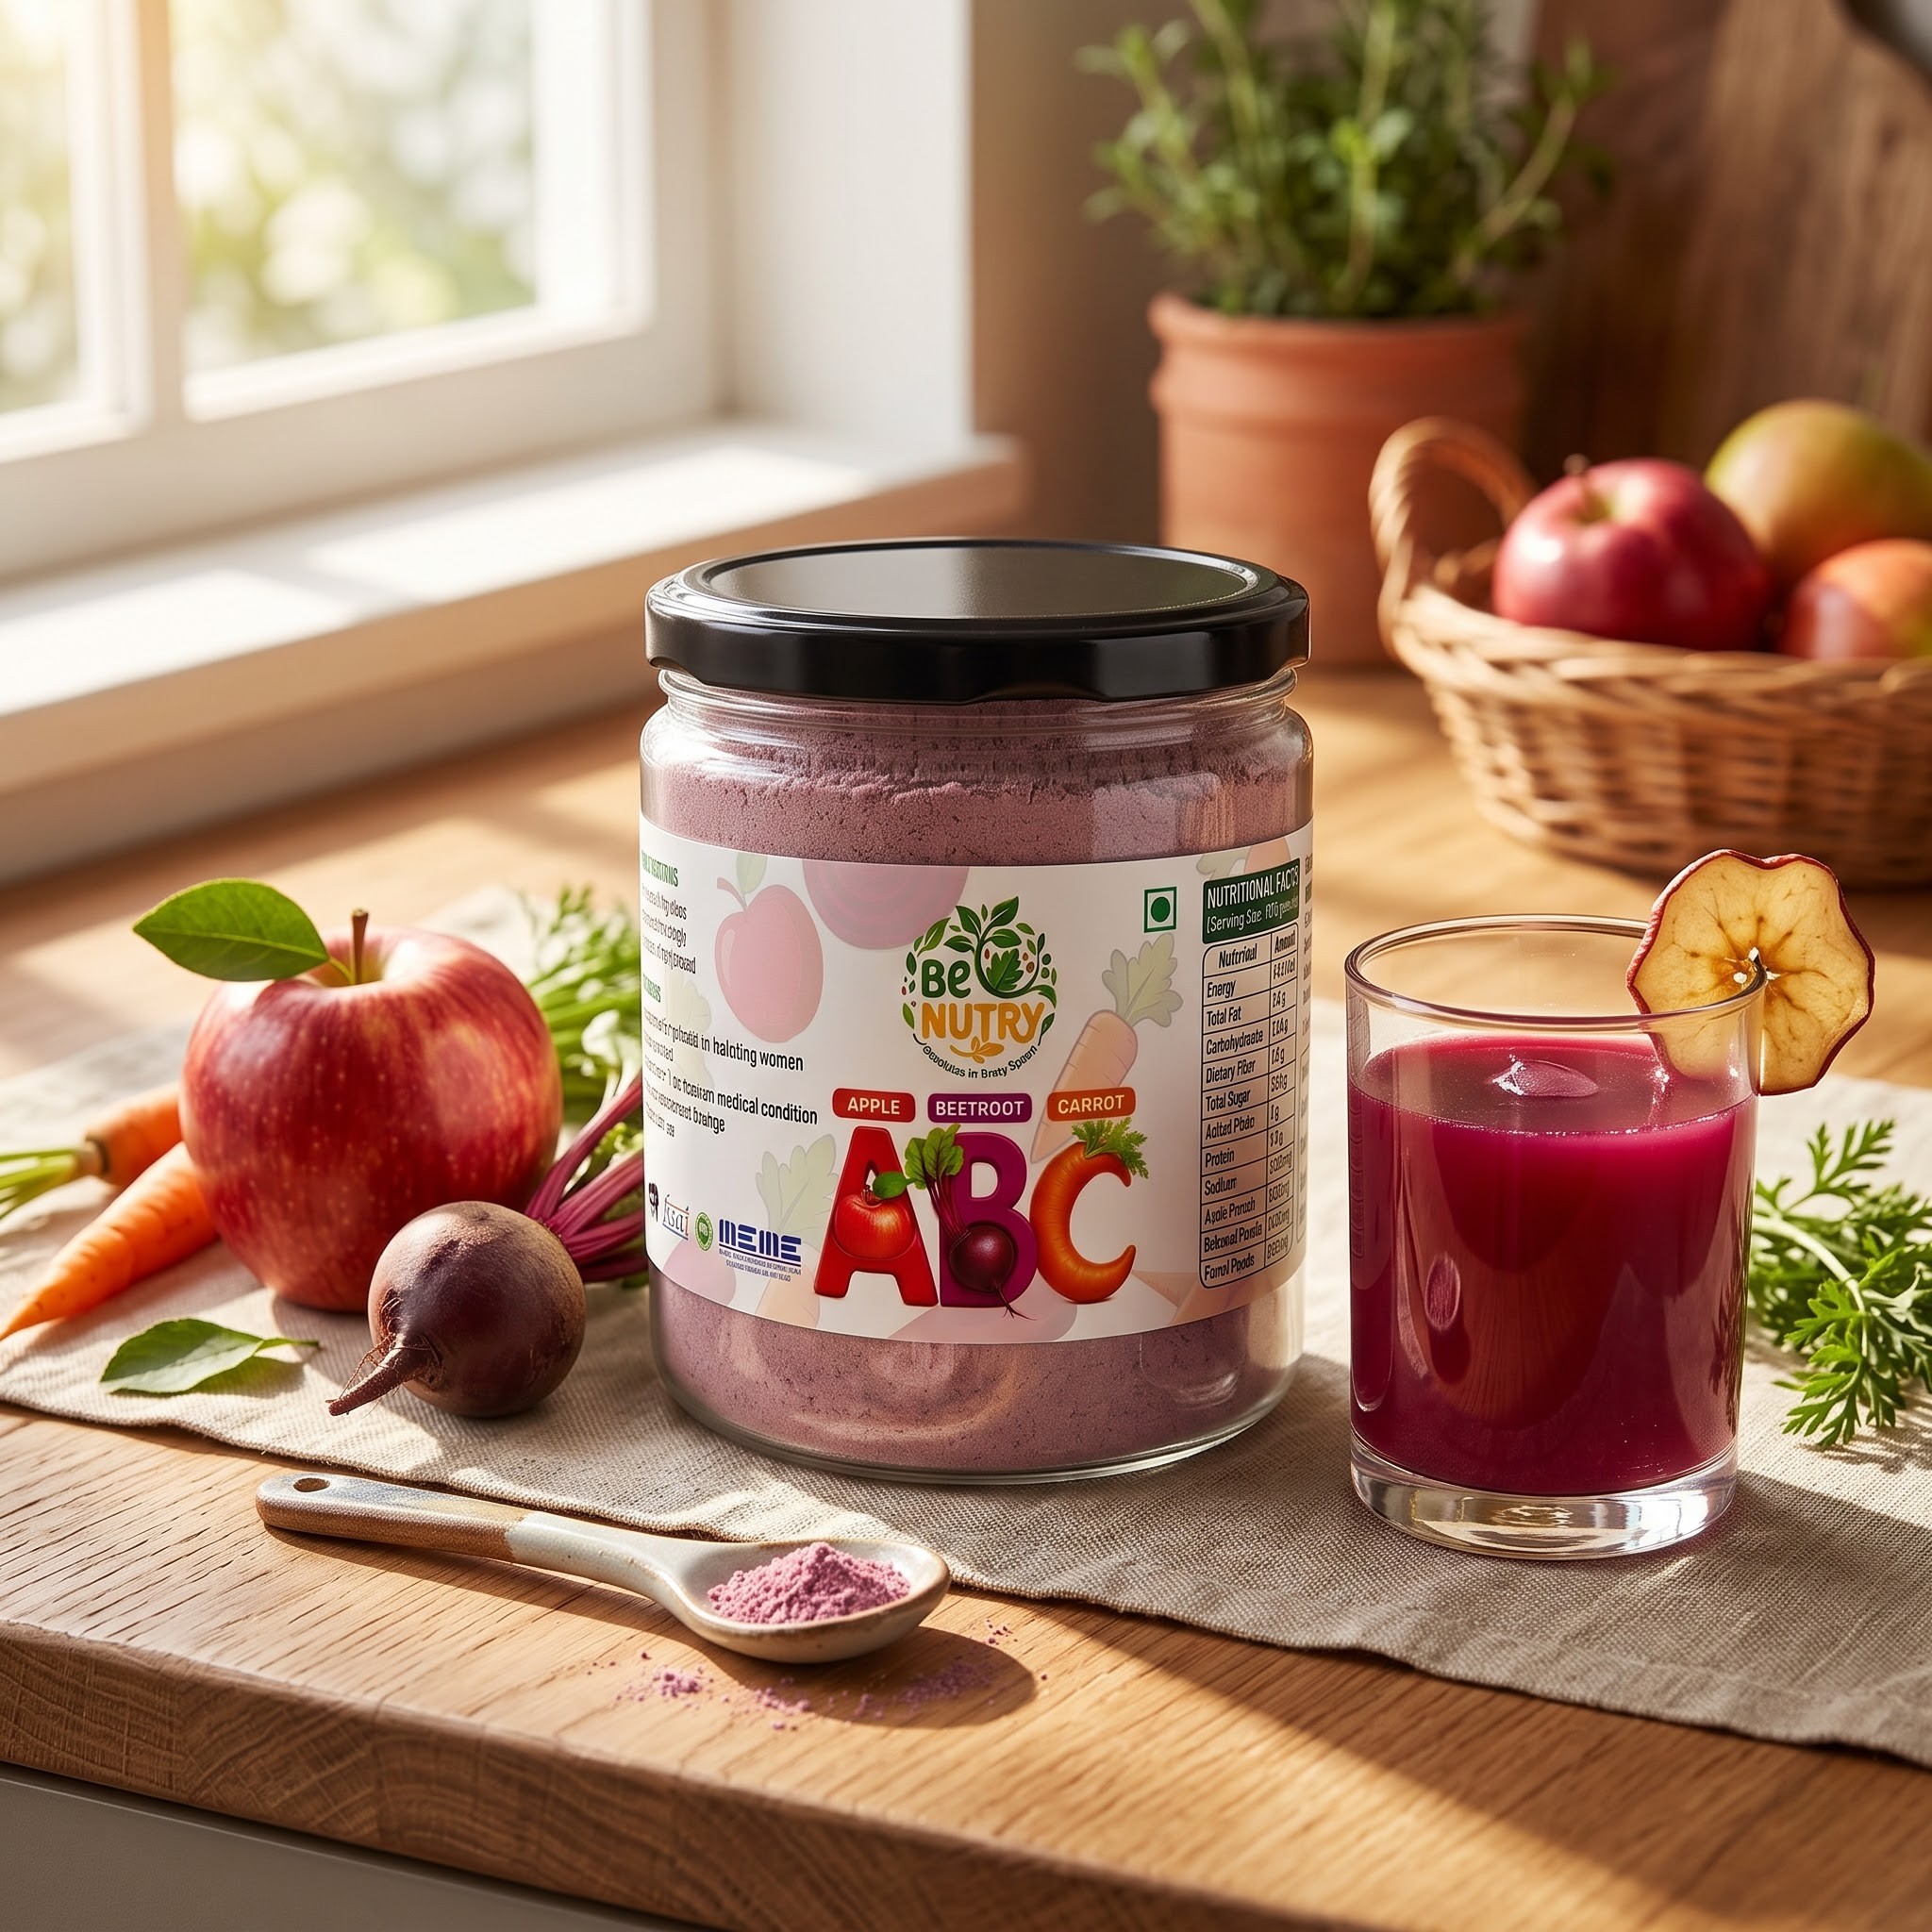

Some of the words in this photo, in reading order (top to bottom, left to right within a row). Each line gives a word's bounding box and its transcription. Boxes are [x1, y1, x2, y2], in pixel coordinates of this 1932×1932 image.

[1208, 875, 1274, 909] NUTRITIONAL
[922, 959, 971, 998] Be
[1207, 979, 1236, 998] Energy
[922, 1002, 1044, 1043] NUTRY
[1207, 1008, 1226, 1026] Total
[1228, 1006, 1241, 1022] Fat
[759, 1050, 804, 1071] women
[1206, 1064, 1235, 1084] Dietary
[717, 1092, 758, 1115] medical
[761, 1101, 818, 1124] condition
[847, 1096, 901, 1115] APPLE
[936, 1100, 1024, 1116] BEETROOT
[1058, 1094, 1125, 1114] CARROT
[1206, 1092, 1226, 1111] Total
[1228, 1090, 1251, 1108] Sugar
[1205, 1148, 1235, 1168] Protein
